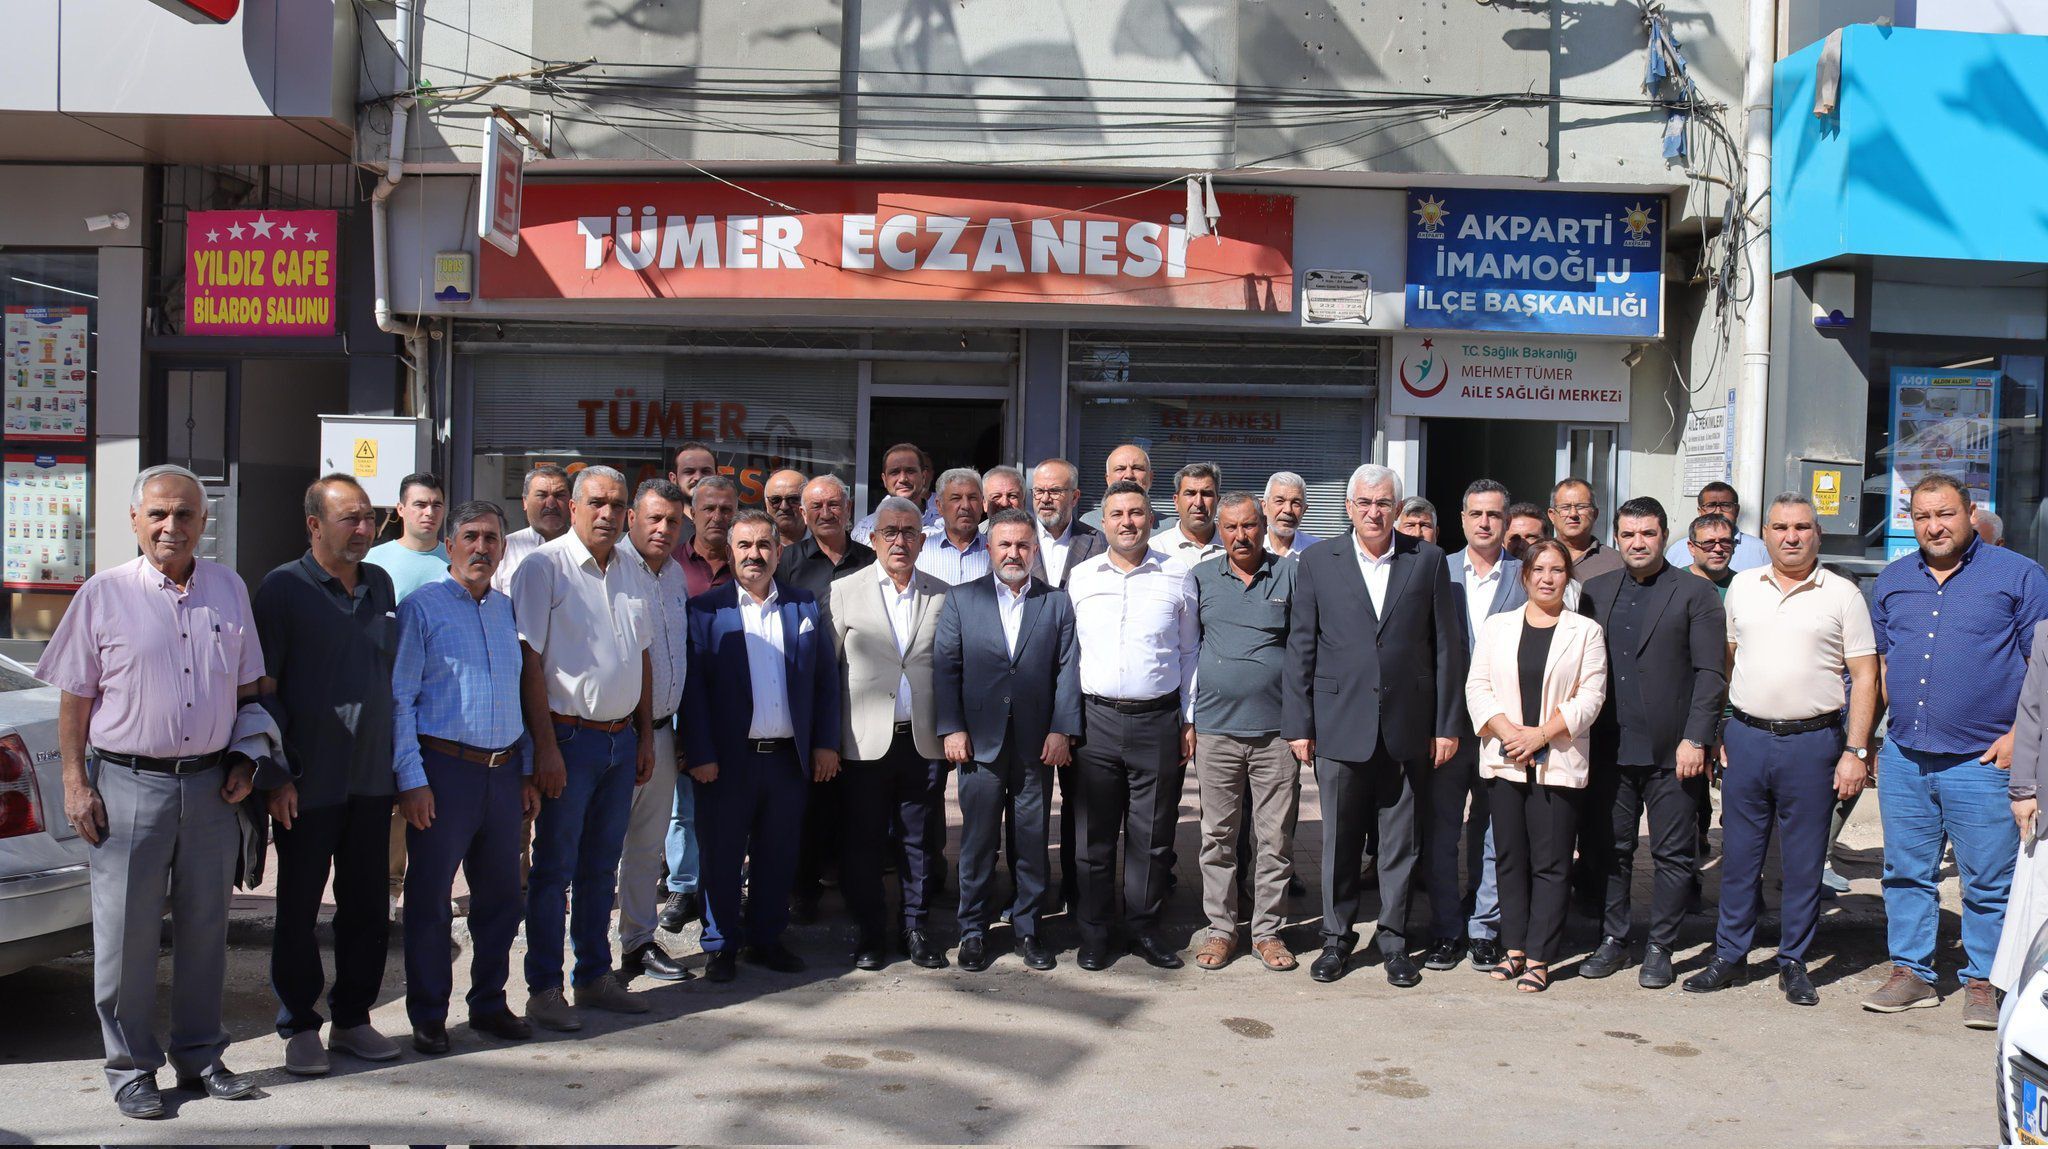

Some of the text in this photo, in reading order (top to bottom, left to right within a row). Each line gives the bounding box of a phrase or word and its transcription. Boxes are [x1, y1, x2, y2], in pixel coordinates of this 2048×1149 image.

[577, 205, 1187, 279] TÜMER ECZANESİ
[1457, 213, 1612, 245] AKPARTİ
[193, 249, 330, 287] YILDIZ CAFE
[1436, 245, 1631, 284] İMAMOĞLU
[193, 288, 329, 325] BİLARDO SALUNU
[1418, 285, 1647, 318] İLÇE BAŞKANLIĞI
[1482, 345, 1519, 360] Sağlık
[1522, 347, 1577, 362] Bakanlığı
[1461, 365, 1573, 380] MEHMET TÜMER
[1496, 384, 1554, 400] SAĞLIĞI
[578, 388, 748, 440] TÜMER
